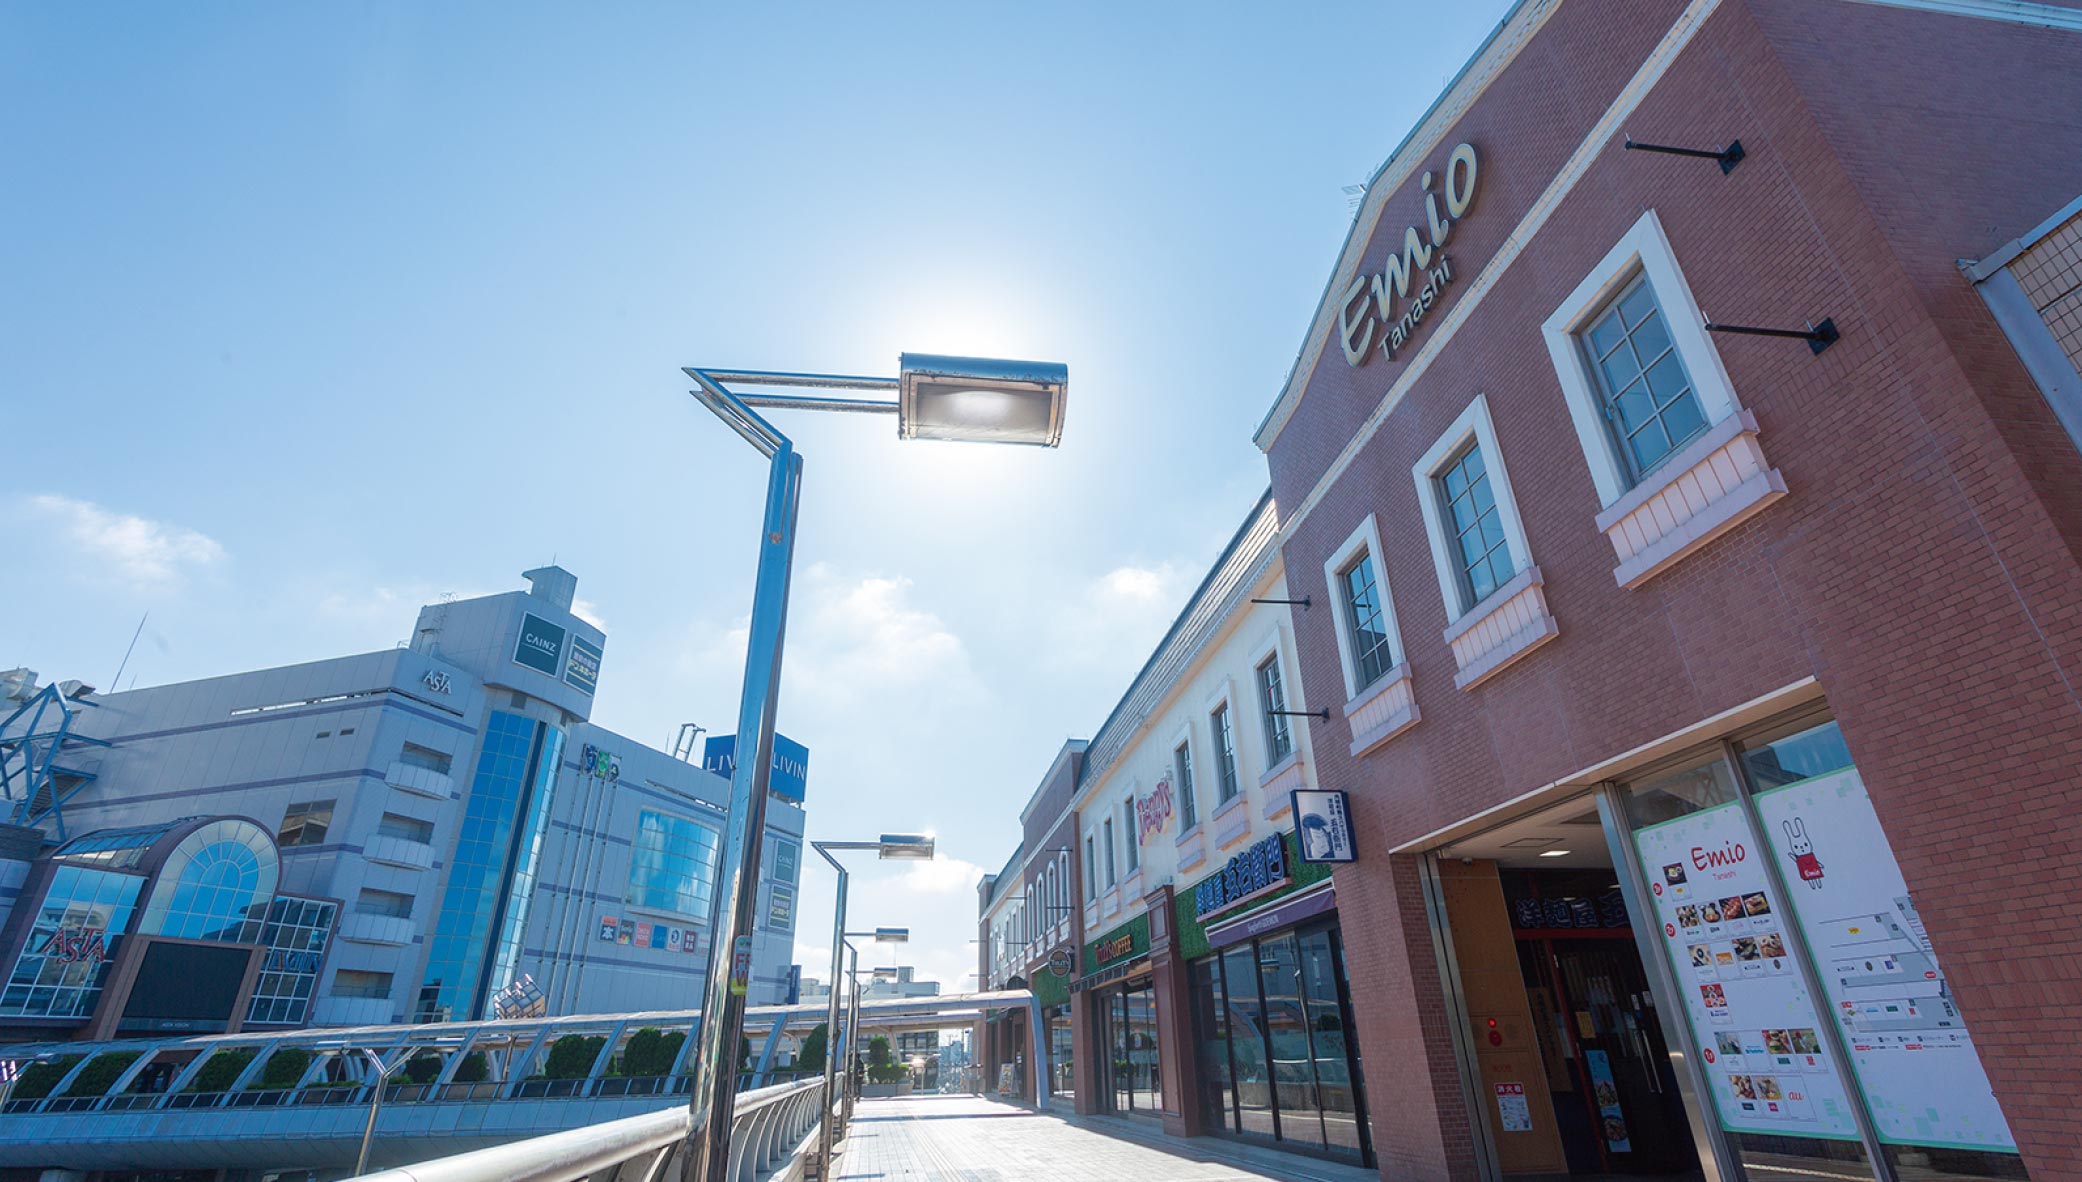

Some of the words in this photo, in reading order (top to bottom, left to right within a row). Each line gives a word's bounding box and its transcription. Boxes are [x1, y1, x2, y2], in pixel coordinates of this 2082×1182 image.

[1338, 143, 1477, 367] Emio
[1378, 255, 1451, 361] Tanashi
[526, 633, 556, 652] CAINZ
[424, 671, 451, 693] ASTA
[773, 752, 805, 780] LIVIN
[1691, 840, 1746, 871] Emio
[42, 927, 105, 963] ASTA
